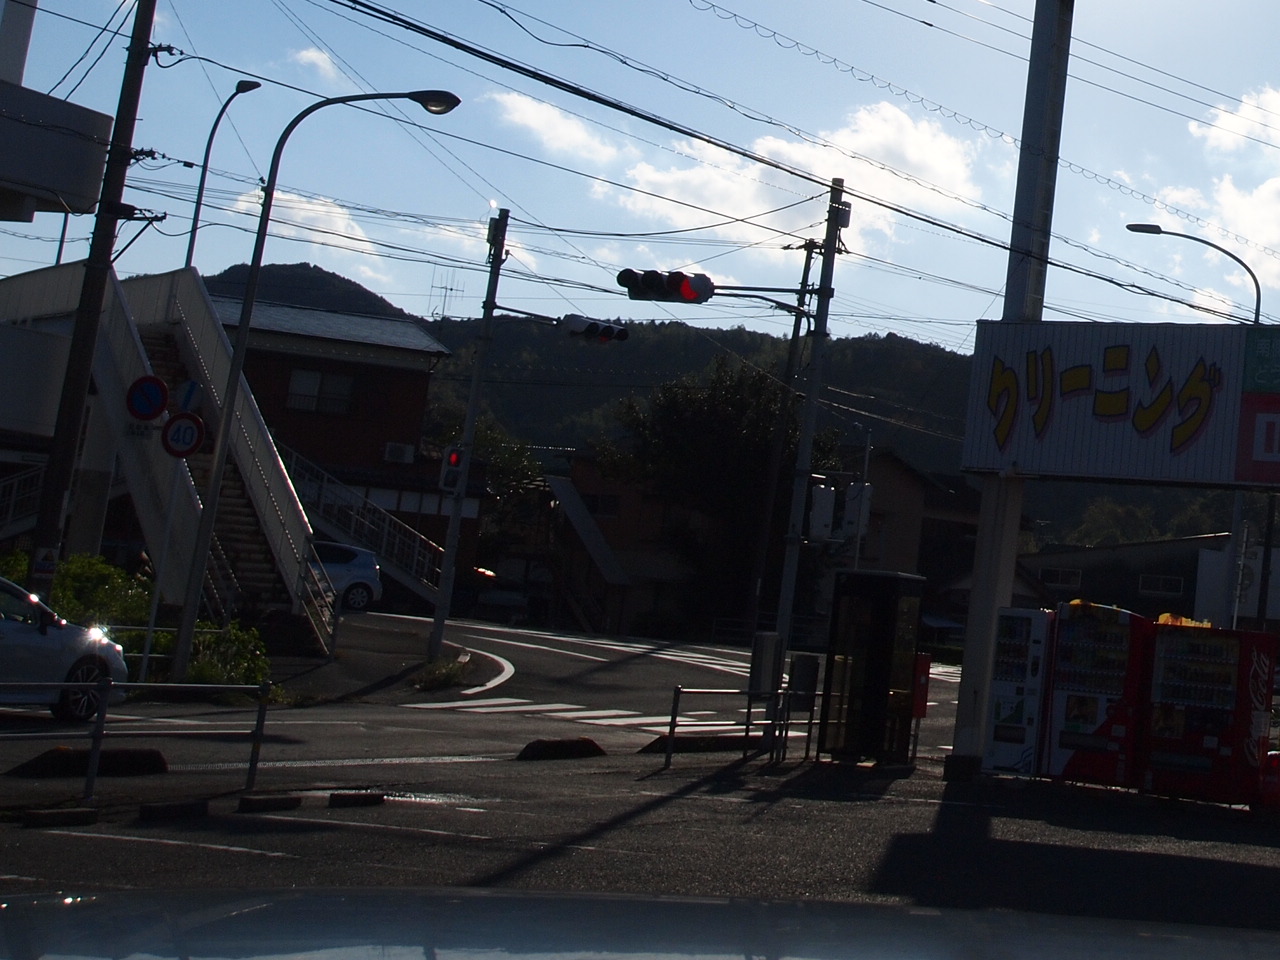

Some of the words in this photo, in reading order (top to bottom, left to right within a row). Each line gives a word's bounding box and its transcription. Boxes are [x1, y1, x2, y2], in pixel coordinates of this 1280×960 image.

[987, 344, 1222, 455] クリーニング
[170, 426, 195, 446] 40
